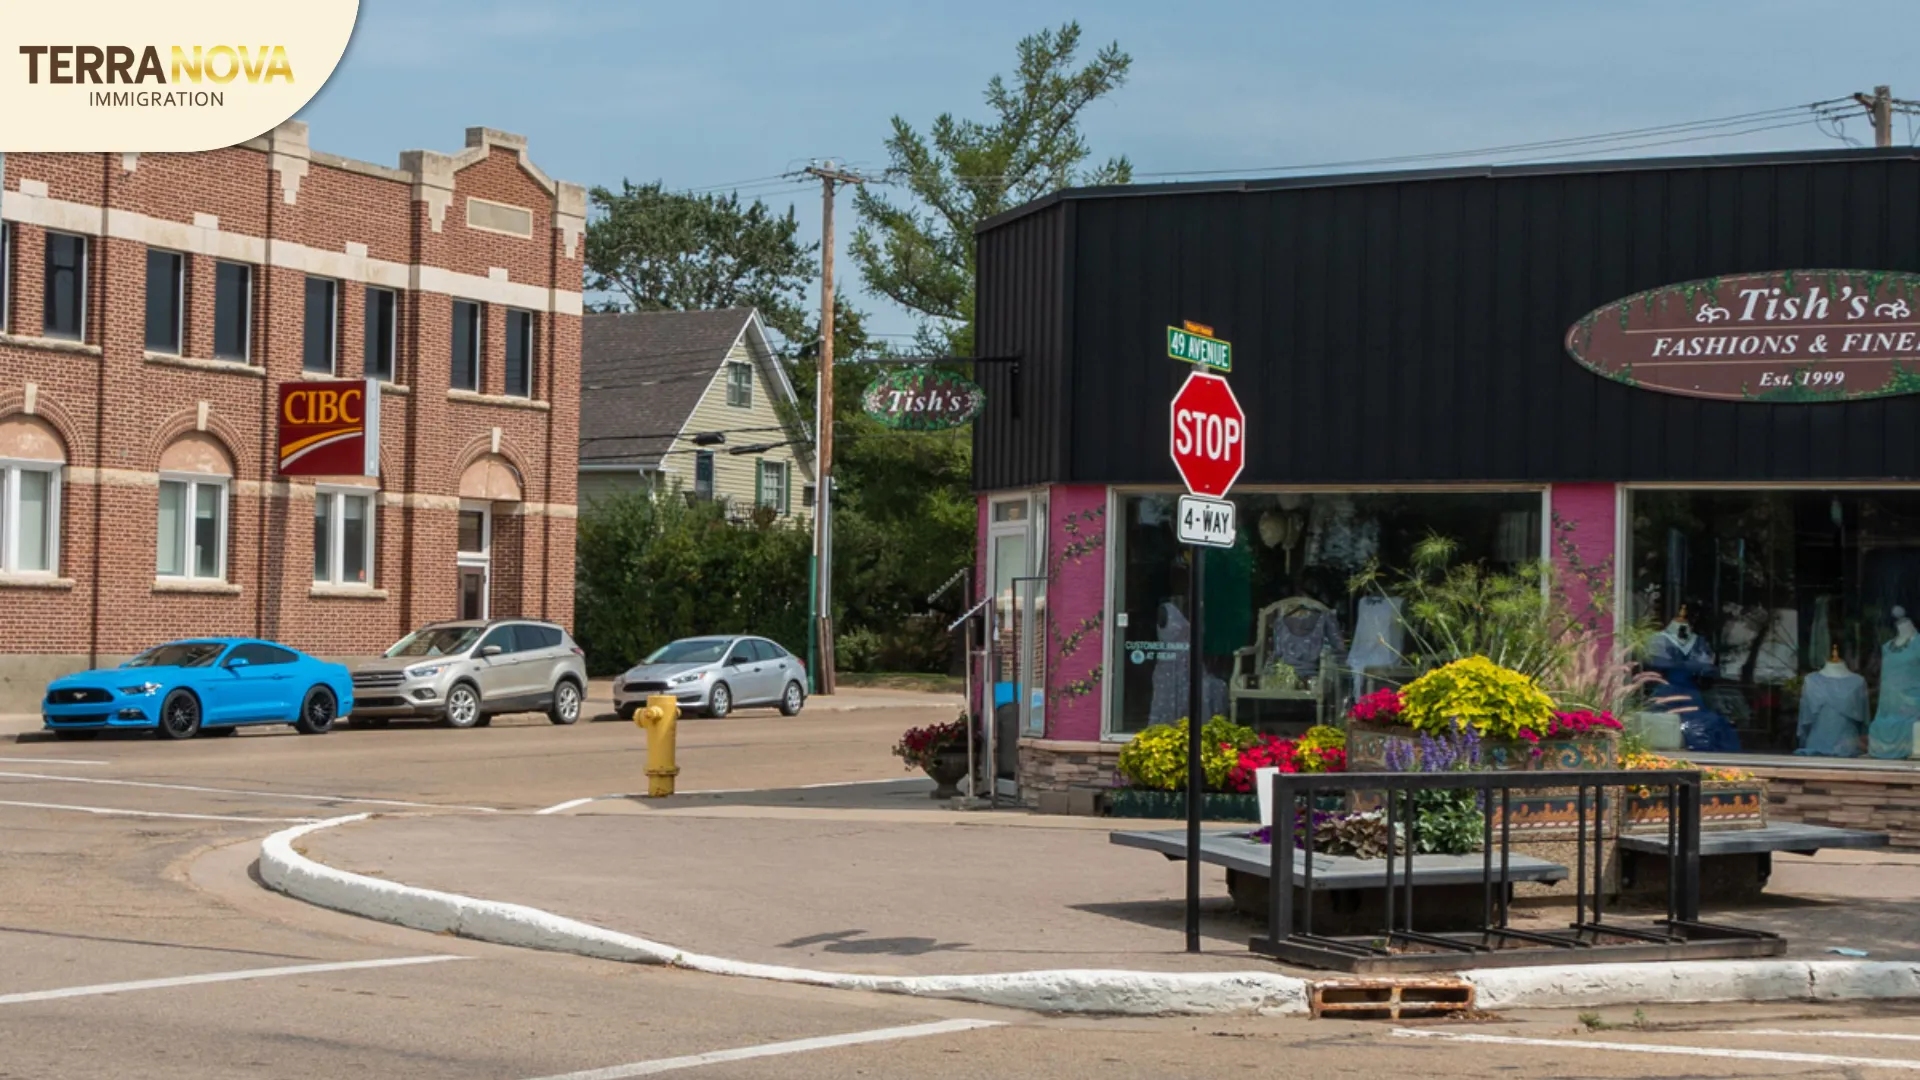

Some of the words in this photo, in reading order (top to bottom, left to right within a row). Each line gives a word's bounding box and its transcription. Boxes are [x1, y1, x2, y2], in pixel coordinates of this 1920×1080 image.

[1738, 286, 1869, 322] Tish's
[1171, 332, 1186, 355] 49
[1188, 336, 1228, 367] AVENUE
[1652, 335, 1799, 358] FASHIONS
[1808, 334, 1828, 354] &
[1841, 332, 1920, 353] FINE
[1759, 372, 1793, 387] Est.
[1801, 371, 1846, 386] 1999
[284, 389, 361, 425] CIBC
[888, 389, 962, 413] Tish's
[1176, 408, 1240, 461] STOP
[1184, 508, 1229, 534] 4-WAY
